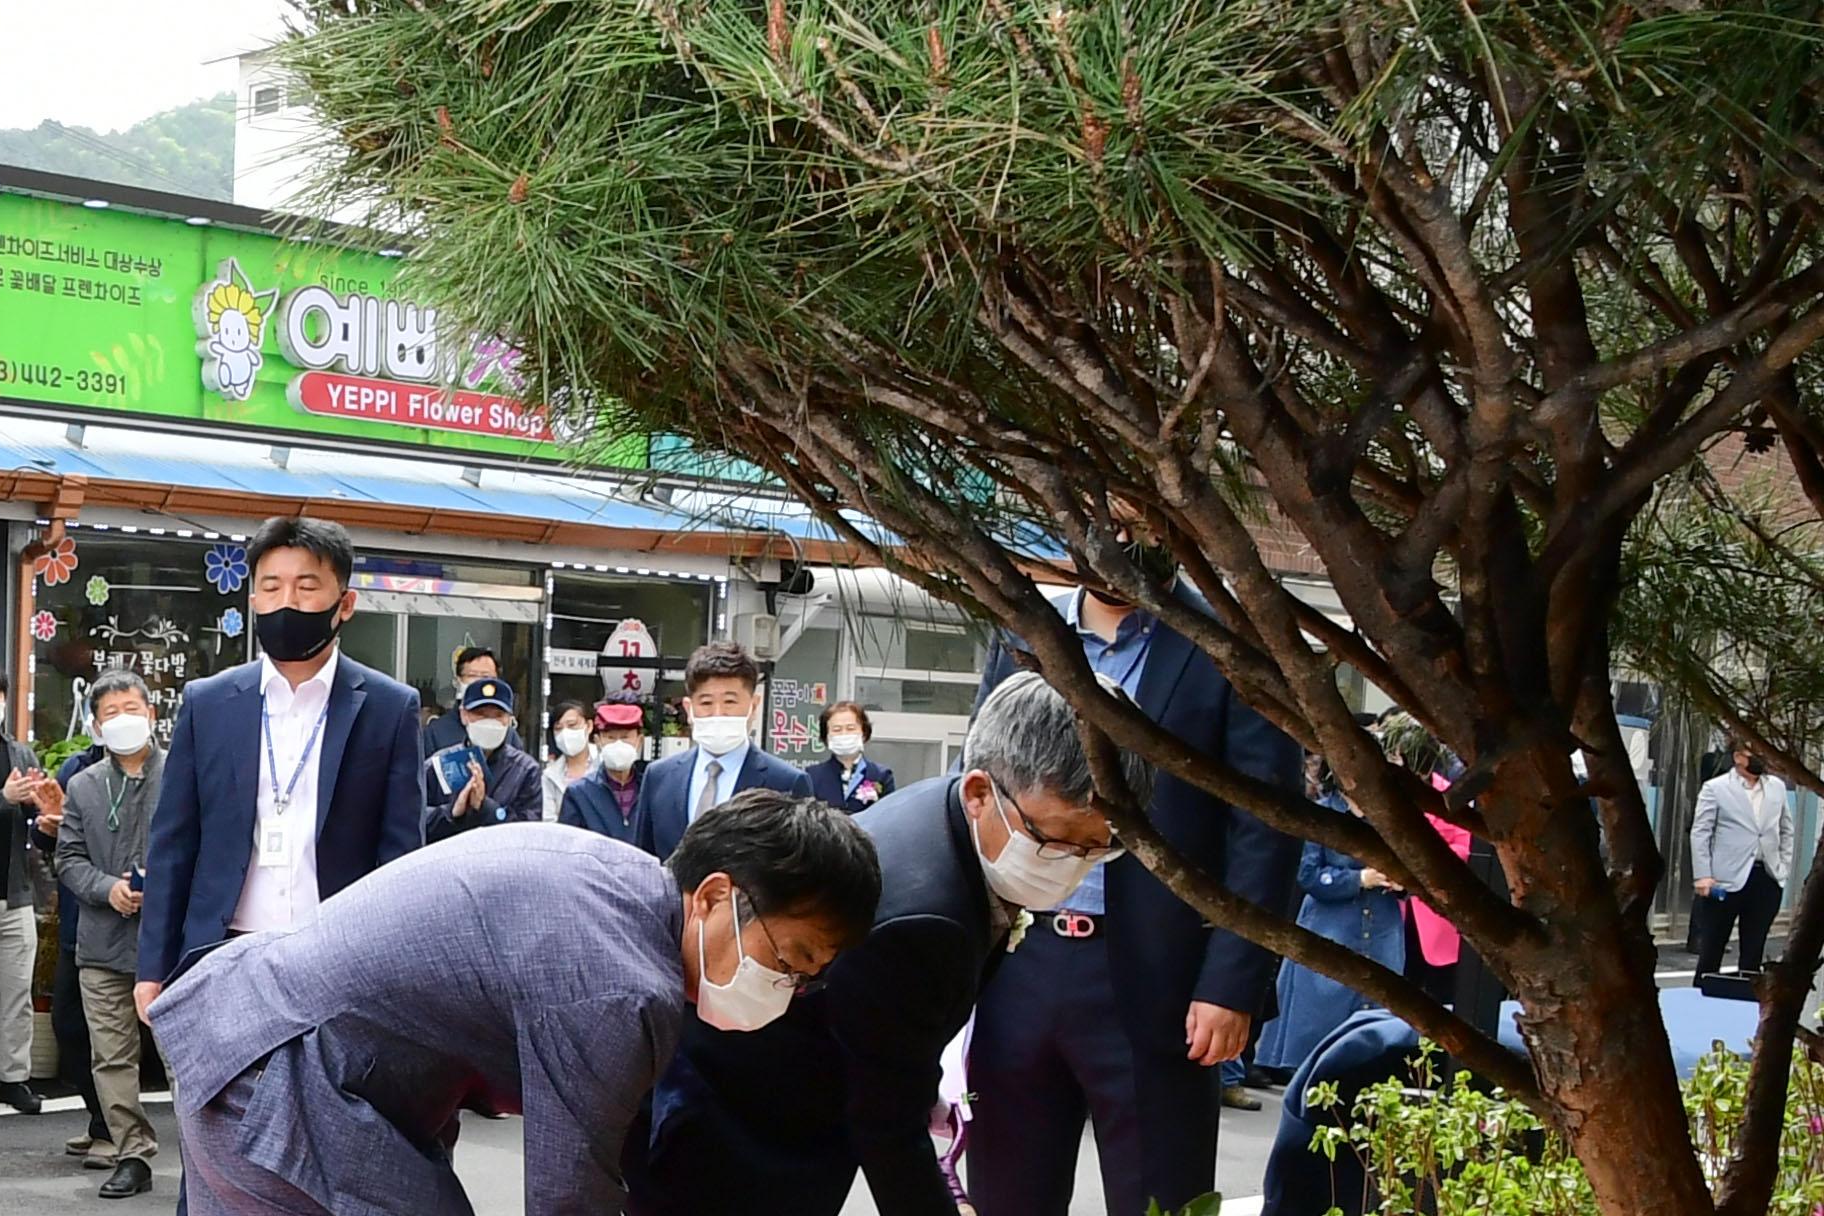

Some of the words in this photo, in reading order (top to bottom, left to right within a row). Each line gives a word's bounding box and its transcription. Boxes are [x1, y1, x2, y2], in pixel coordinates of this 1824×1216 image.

[104, 250, 162, 277] 대상수상
[10, 269, 57, 295] 꽃배달
[62, 276, 142, 306] 프렌차이즈
[320, 272, 369, 295] since
[327, 383, 398, 415] YEPPI
[408, 393, 483, 425] Flower
[488, 404, 545, 437] Shop
